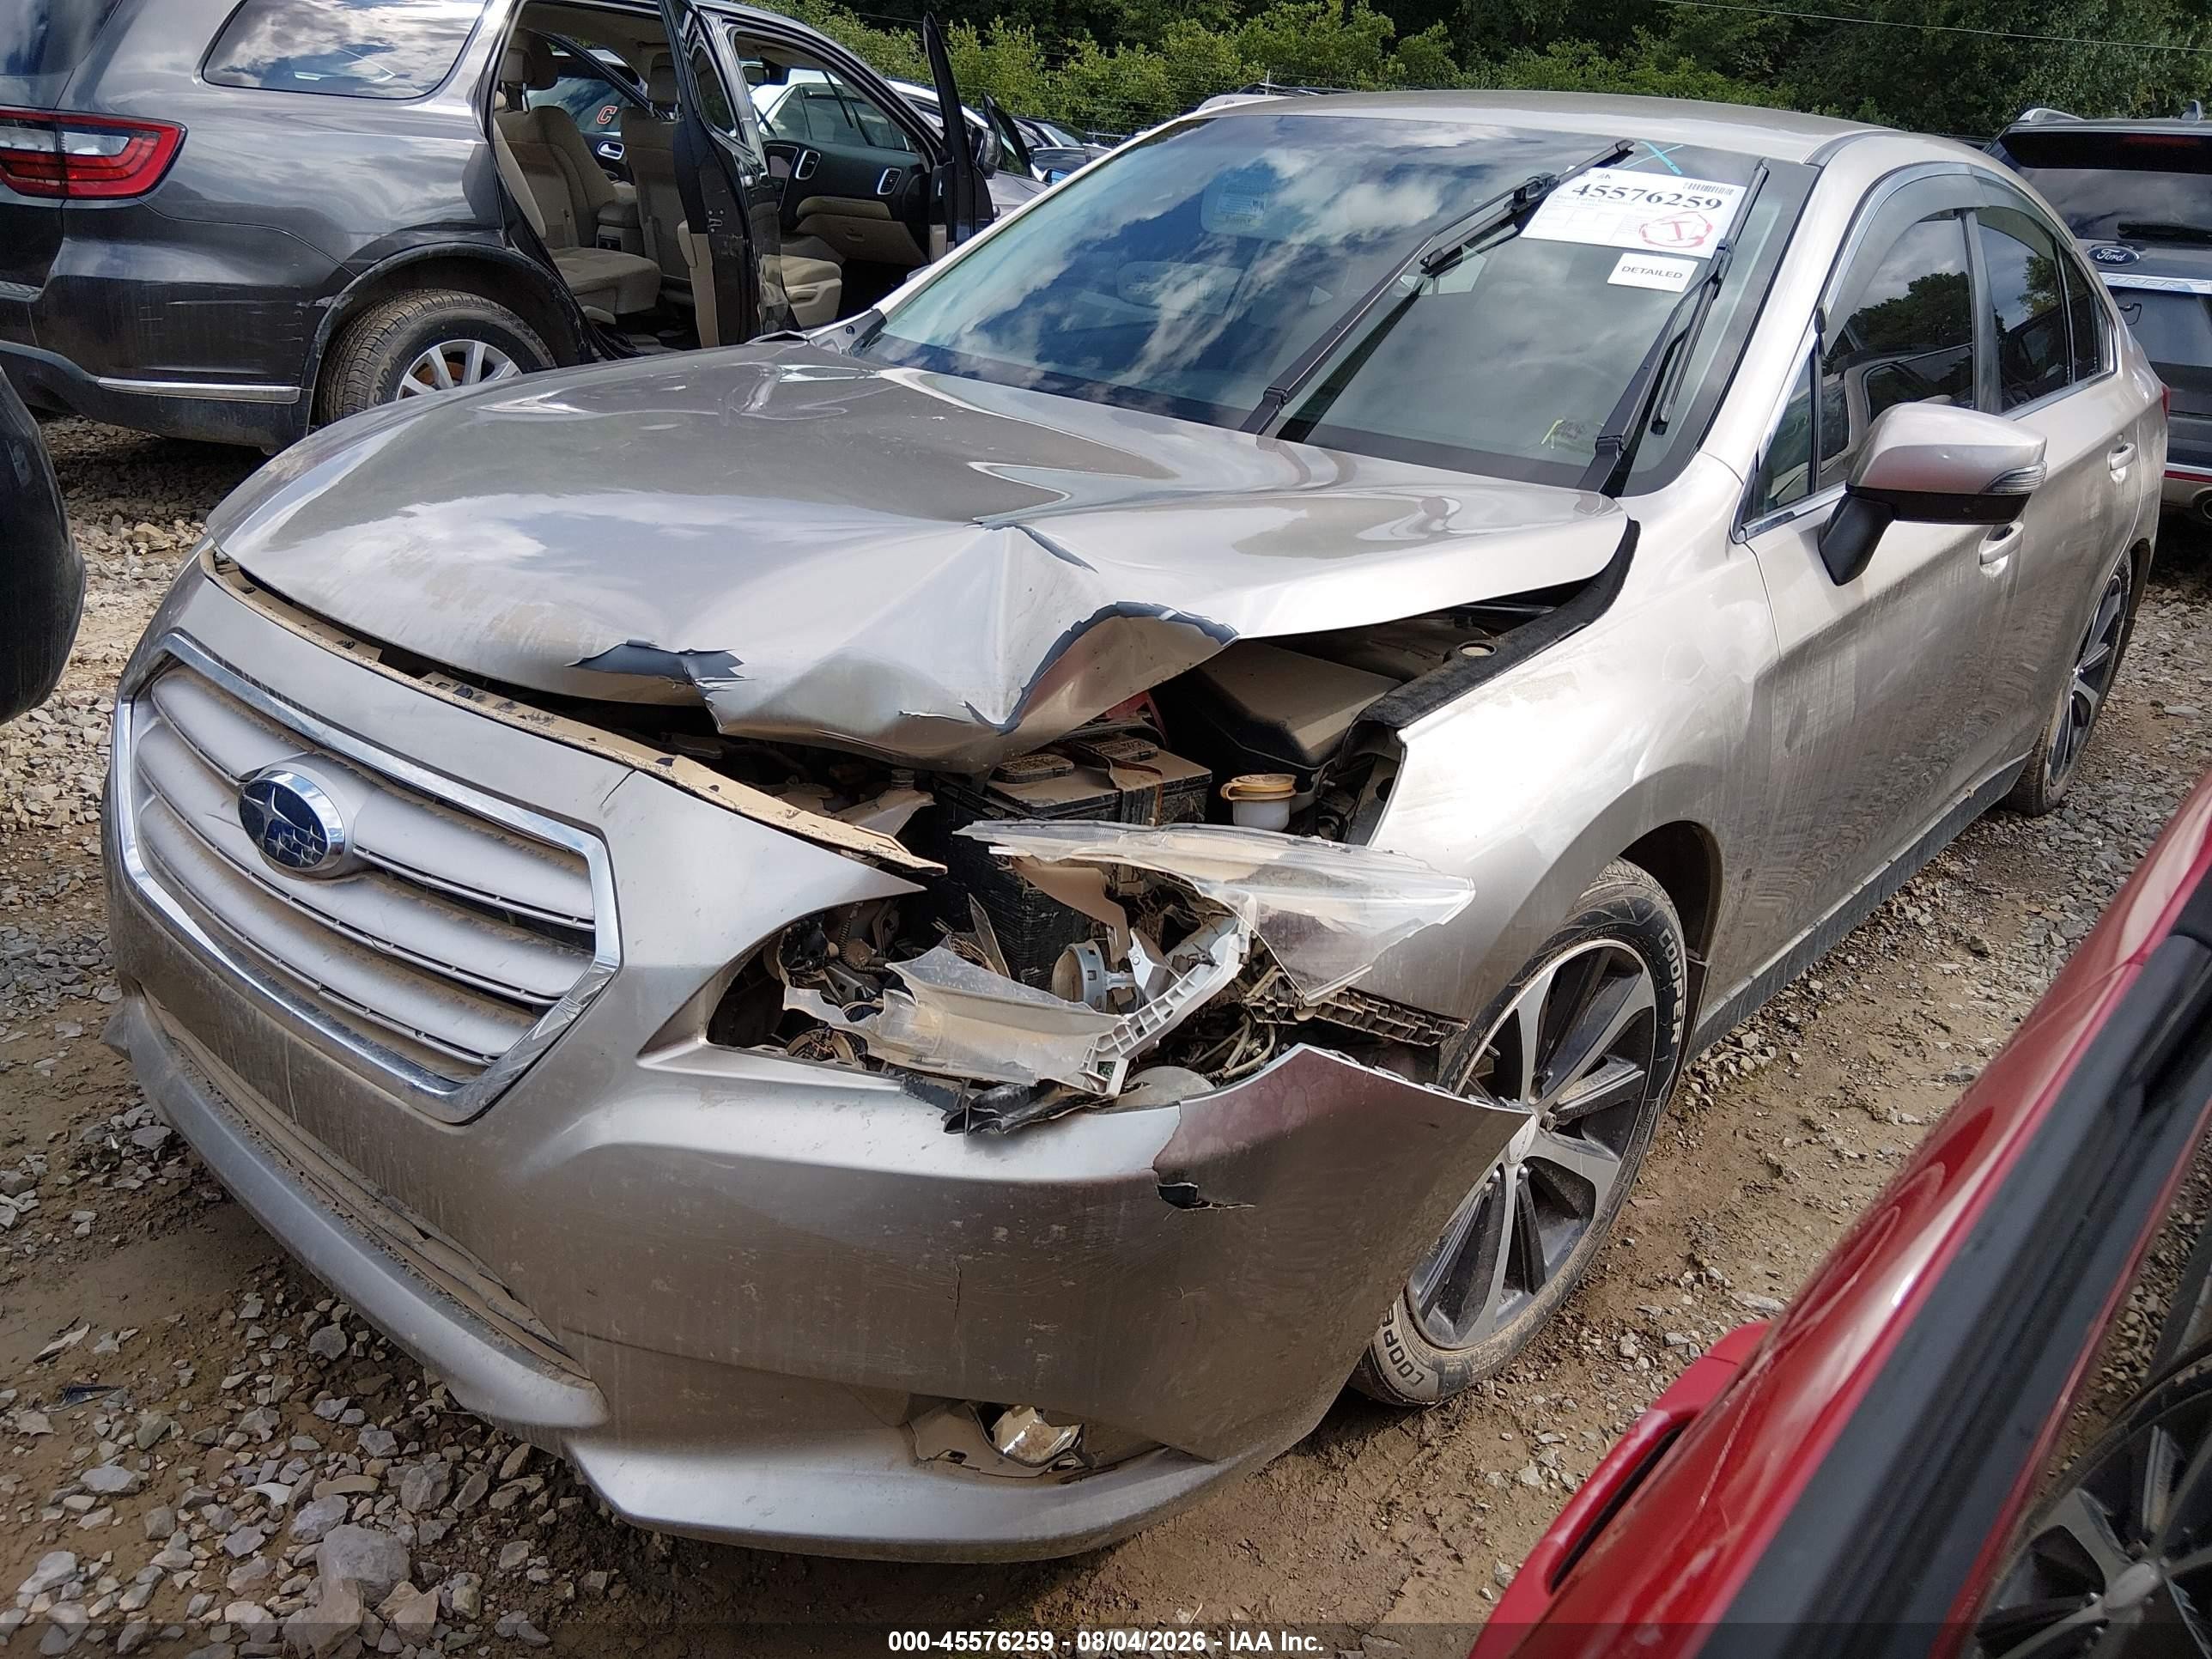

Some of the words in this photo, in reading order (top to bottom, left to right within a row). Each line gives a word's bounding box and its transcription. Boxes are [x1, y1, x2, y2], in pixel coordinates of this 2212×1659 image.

[596, 105, 618, 125] C
[1571, 183, 1723, 210] 45576259
[2096, 248, 2128, 262] Ford
[1621, 265, 1683, 279] DETAILED
[2104, 275, 2179, 289] ORER
[1658, 927, 1683, 1045] COOPER
[1382, 1304, 1425, 1388] COOPE
